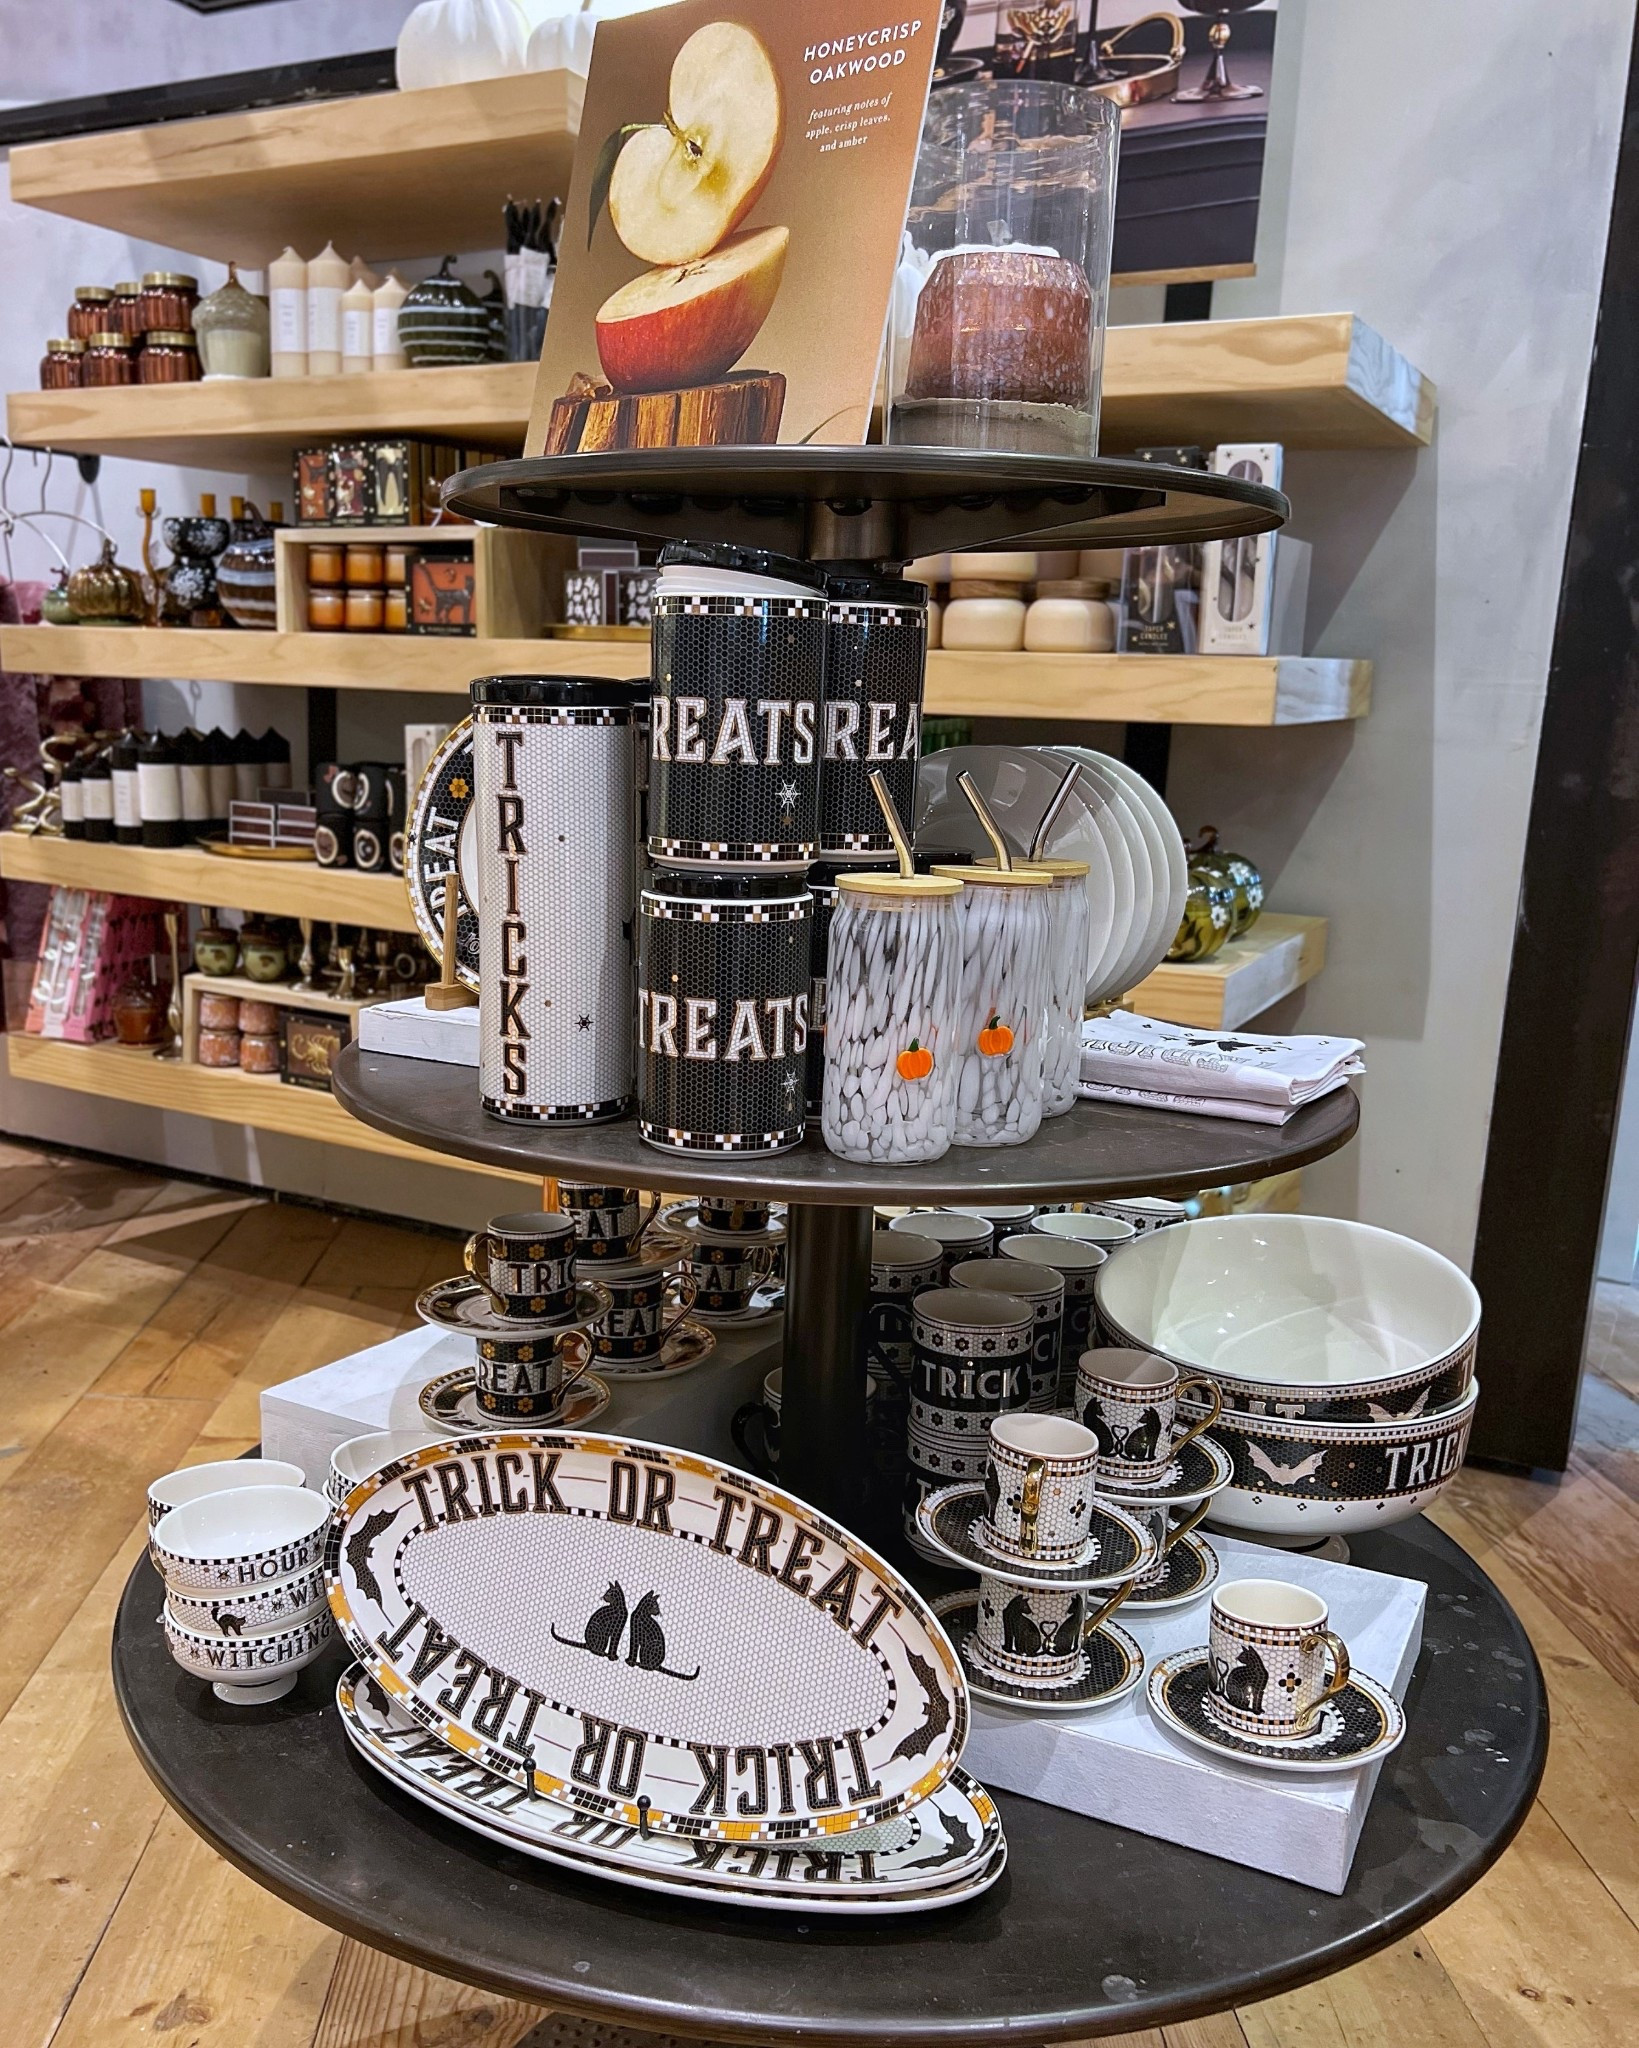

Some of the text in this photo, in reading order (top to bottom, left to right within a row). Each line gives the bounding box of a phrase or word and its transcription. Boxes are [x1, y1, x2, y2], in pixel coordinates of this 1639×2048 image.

[804, 19, 921, 63] HONEYCRISP
[809, 49, 906, 85] OAKWOOD
[808, 91, 893, 125] featuring notes of
[835, 121, 858, 133] crisp
[820, 136, 868, 153] and amber
[496, 730, 532, 1098] TRICKS
[921, 1360, 1021, 1400] TRICK
[237, 1547, 309, 1584] HOUR
[400, 1452, 903, 1650] TRICK OR TREAT
[206, 1619, 331, 1669] WITCHING
[376, 1603, 882, 1817] TRICK OR TREAT
